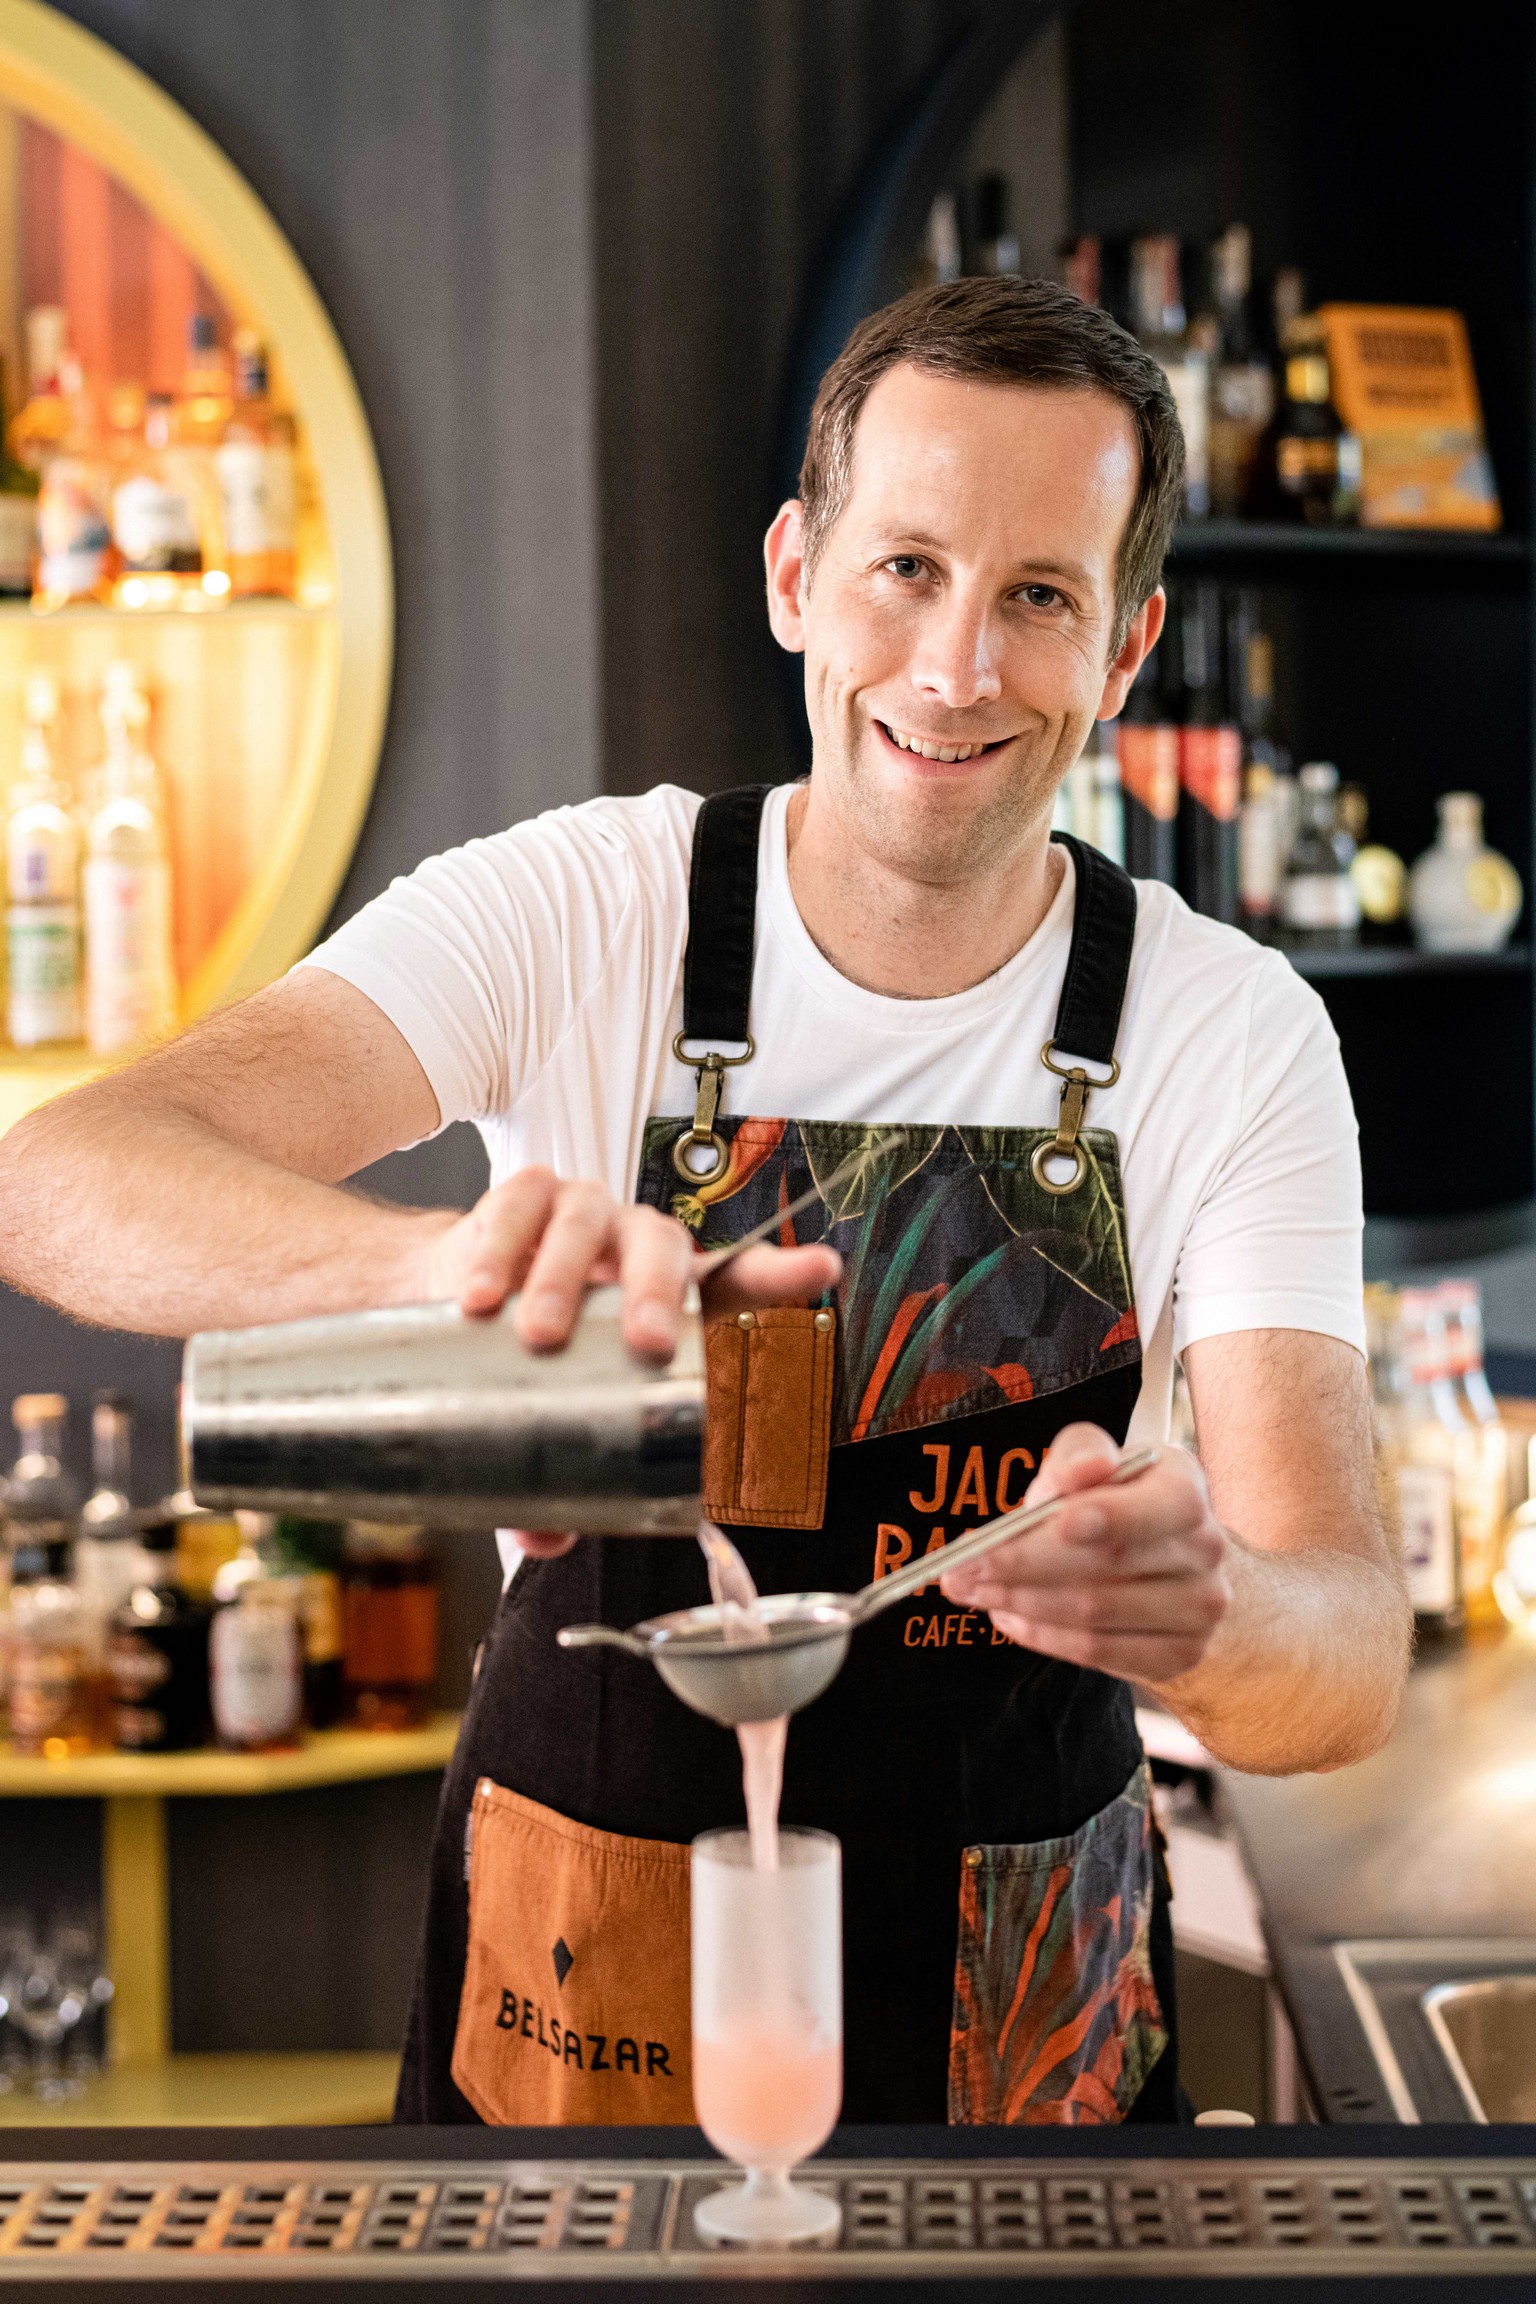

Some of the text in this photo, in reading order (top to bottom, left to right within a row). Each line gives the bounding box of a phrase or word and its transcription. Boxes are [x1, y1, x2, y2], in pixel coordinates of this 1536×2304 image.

[909, 1443, 1053, 1516] JAC
[873, 1522, 977, 1597] RA
[496, 1987, 674, 2077] BELSAZAR
